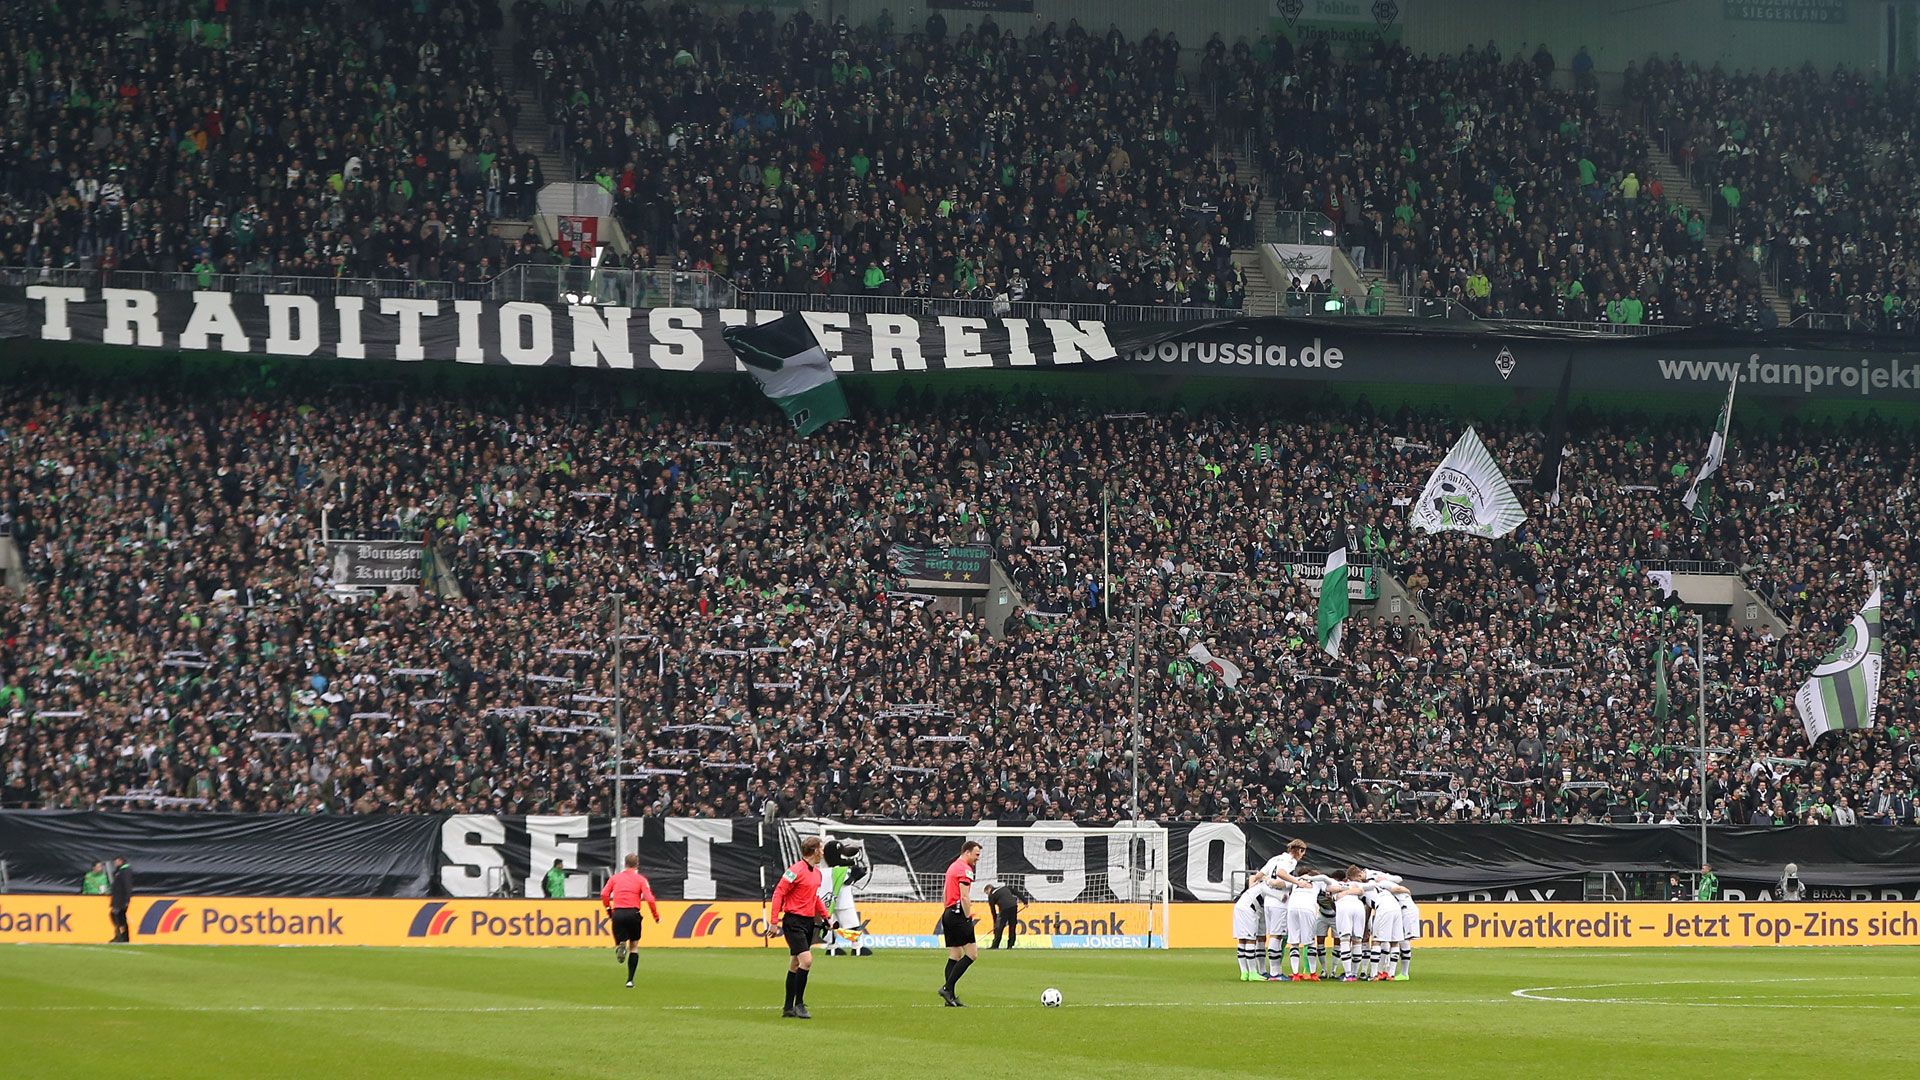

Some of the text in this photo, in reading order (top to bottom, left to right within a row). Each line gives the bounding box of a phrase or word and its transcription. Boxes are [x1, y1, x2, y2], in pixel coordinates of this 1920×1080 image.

[1743, 6, 1828, 21] SIEGERLAND
[925, 559, 980, 571] FEUER 2010
[1812, 889, 1846, 899] BRAX
[202, 908, 344, 935] Postbank
[471, 910, 611, 938] Postbank
[1016, 912, 1125, 936] ostbank
[1463, 911, 1631, 938] Privatkredit
[1663, 913, 1730, 938] Jetzt
[1738, 911, 1859, 943] Top-Zins
[1868, 910, 1918, 937] sich
[1083, 936, 1142, 948] JONGEN
